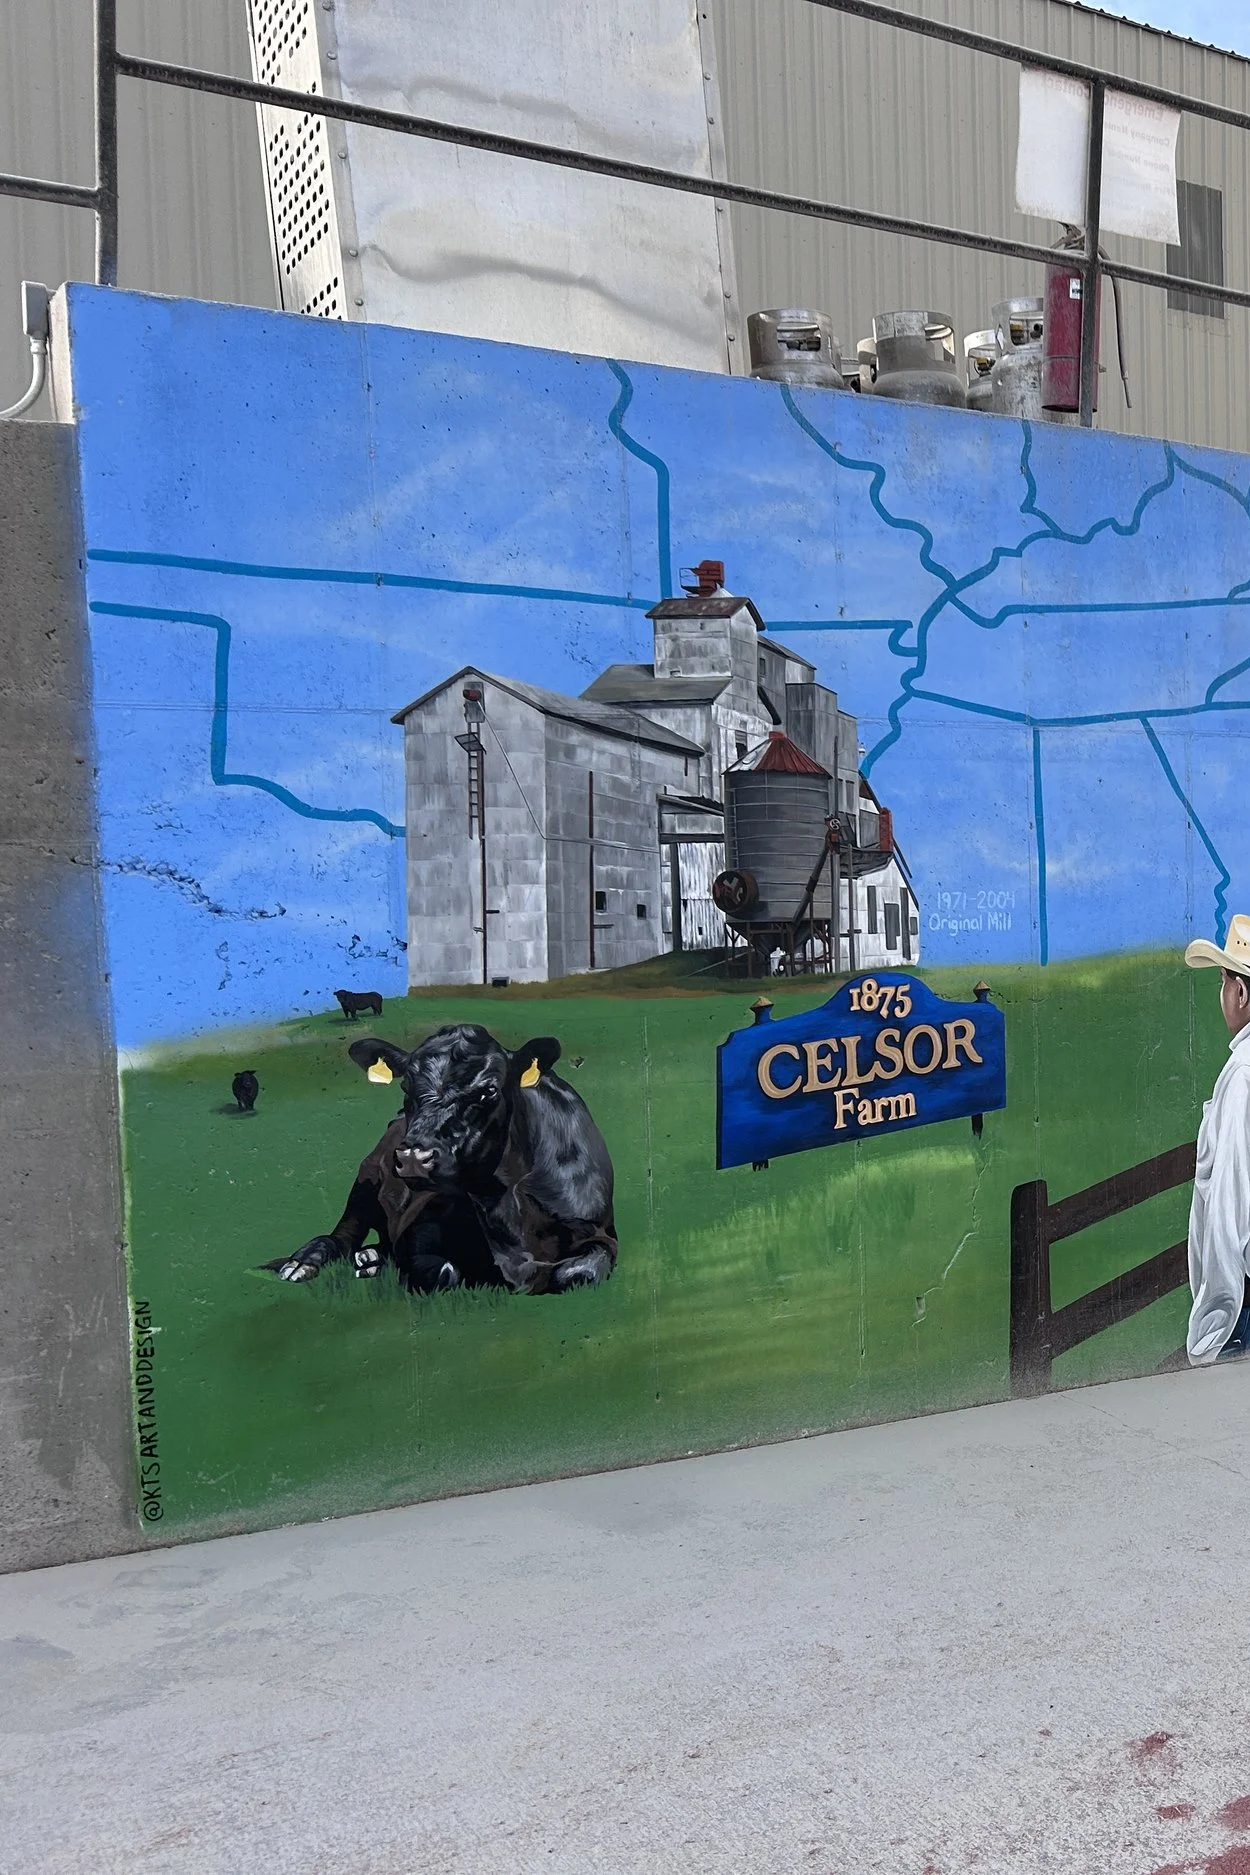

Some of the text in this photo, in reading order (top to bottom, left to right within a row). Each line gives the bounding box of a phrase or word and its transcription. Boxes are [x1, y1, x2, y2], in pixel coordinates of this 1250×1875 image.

[937, 890, 1016, 910] 1971-2004
[928, 911, 1012, 936] Original Mill
[849, 978, 913, 1019] 1875
[757, 1018, 983, 1099] CELSOR
[833, 1087, 917, 1130] Farm
